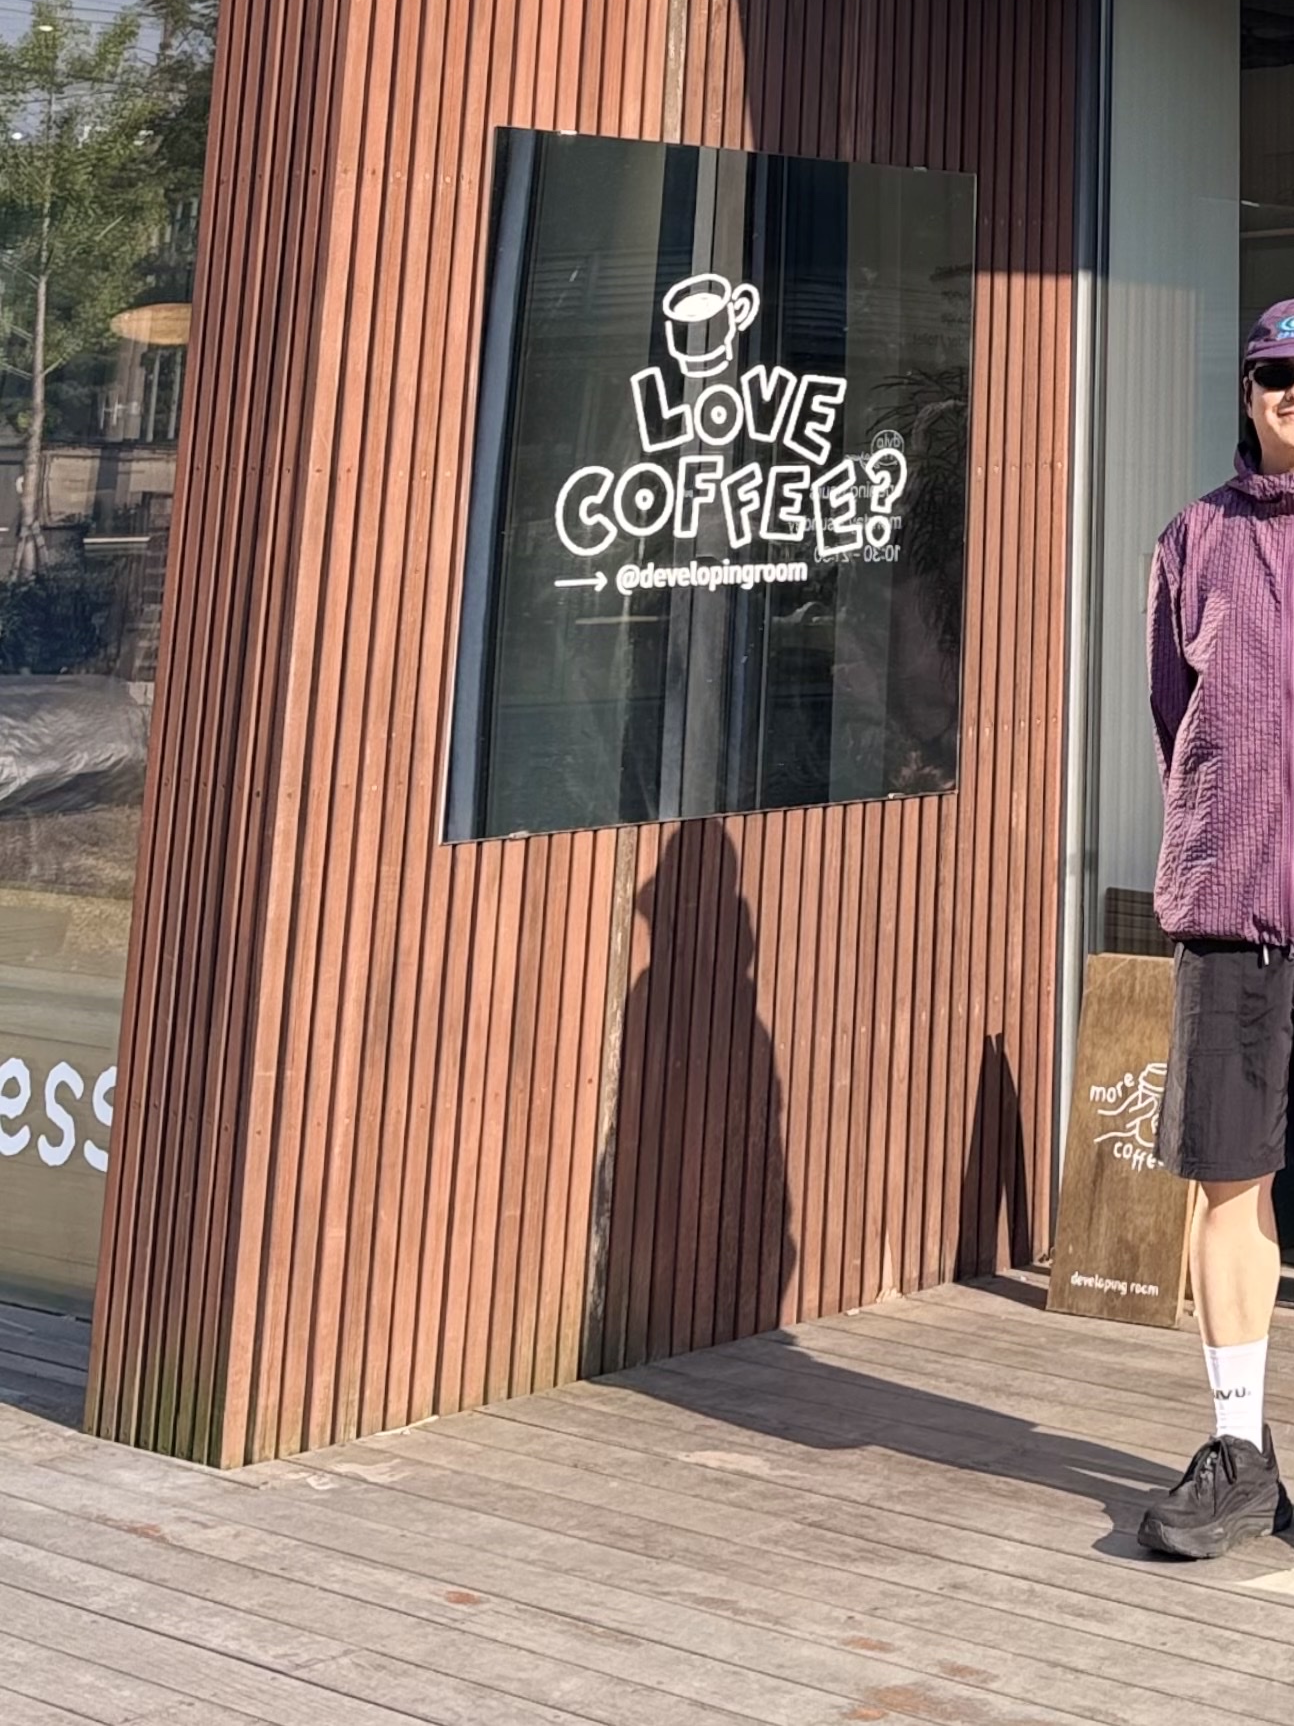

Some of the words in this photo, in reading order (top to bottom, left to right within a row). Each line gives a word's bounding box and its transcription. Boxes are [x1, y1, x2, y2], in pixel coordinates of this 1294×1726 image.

[630, 364, 847, 465] LOVE
[555, 447, 908, 557] COFFEE?
[615, 558, 808, 596] @developingroom
[1089, 1073, 1135, 1103] more
[1070, 1270, 1128, 1296] developing
[1129, 1281, 1159, 1297] room
